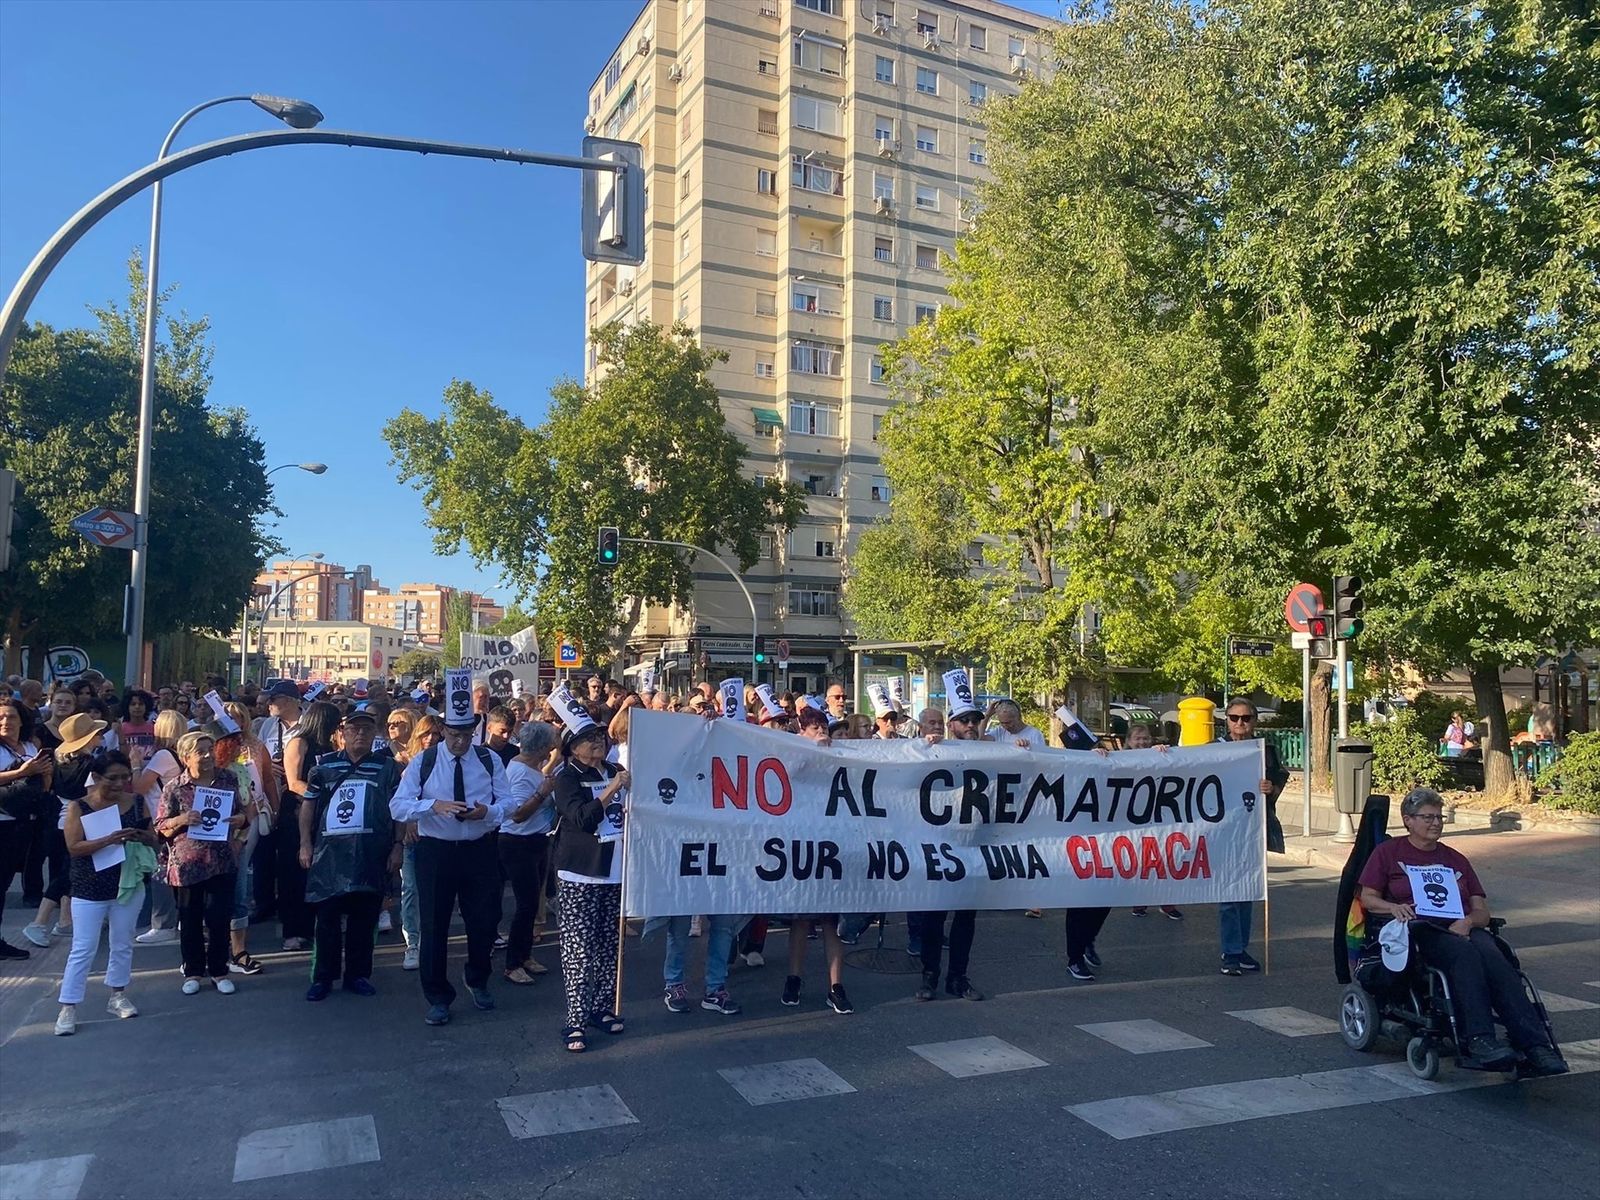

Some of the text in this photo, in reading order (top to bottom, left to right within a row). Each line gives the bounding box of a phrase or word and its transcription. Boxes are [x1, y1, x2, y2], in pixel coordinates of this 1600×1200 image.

[74, 520, 94, 529] Metro
[484, 640, 514, 656] NO
[562, 649, 575, 657] 20
[461, 652, 538, 670] CREMATORIO
[452, 676, 469, 690] NO
[953, 675, 968, 686] NO
[198, 788, 232, 797] CREMATORIO
[339, 788, 355, 801] NO
[712, 755, 1225, 826] NO AL CREMATORIO
[204, 795, 222, 809] NO
[680, 832, 1212, 882] EL SUR NO ES UNA CLOACA
[1421, 872, 1444, 884] NO
